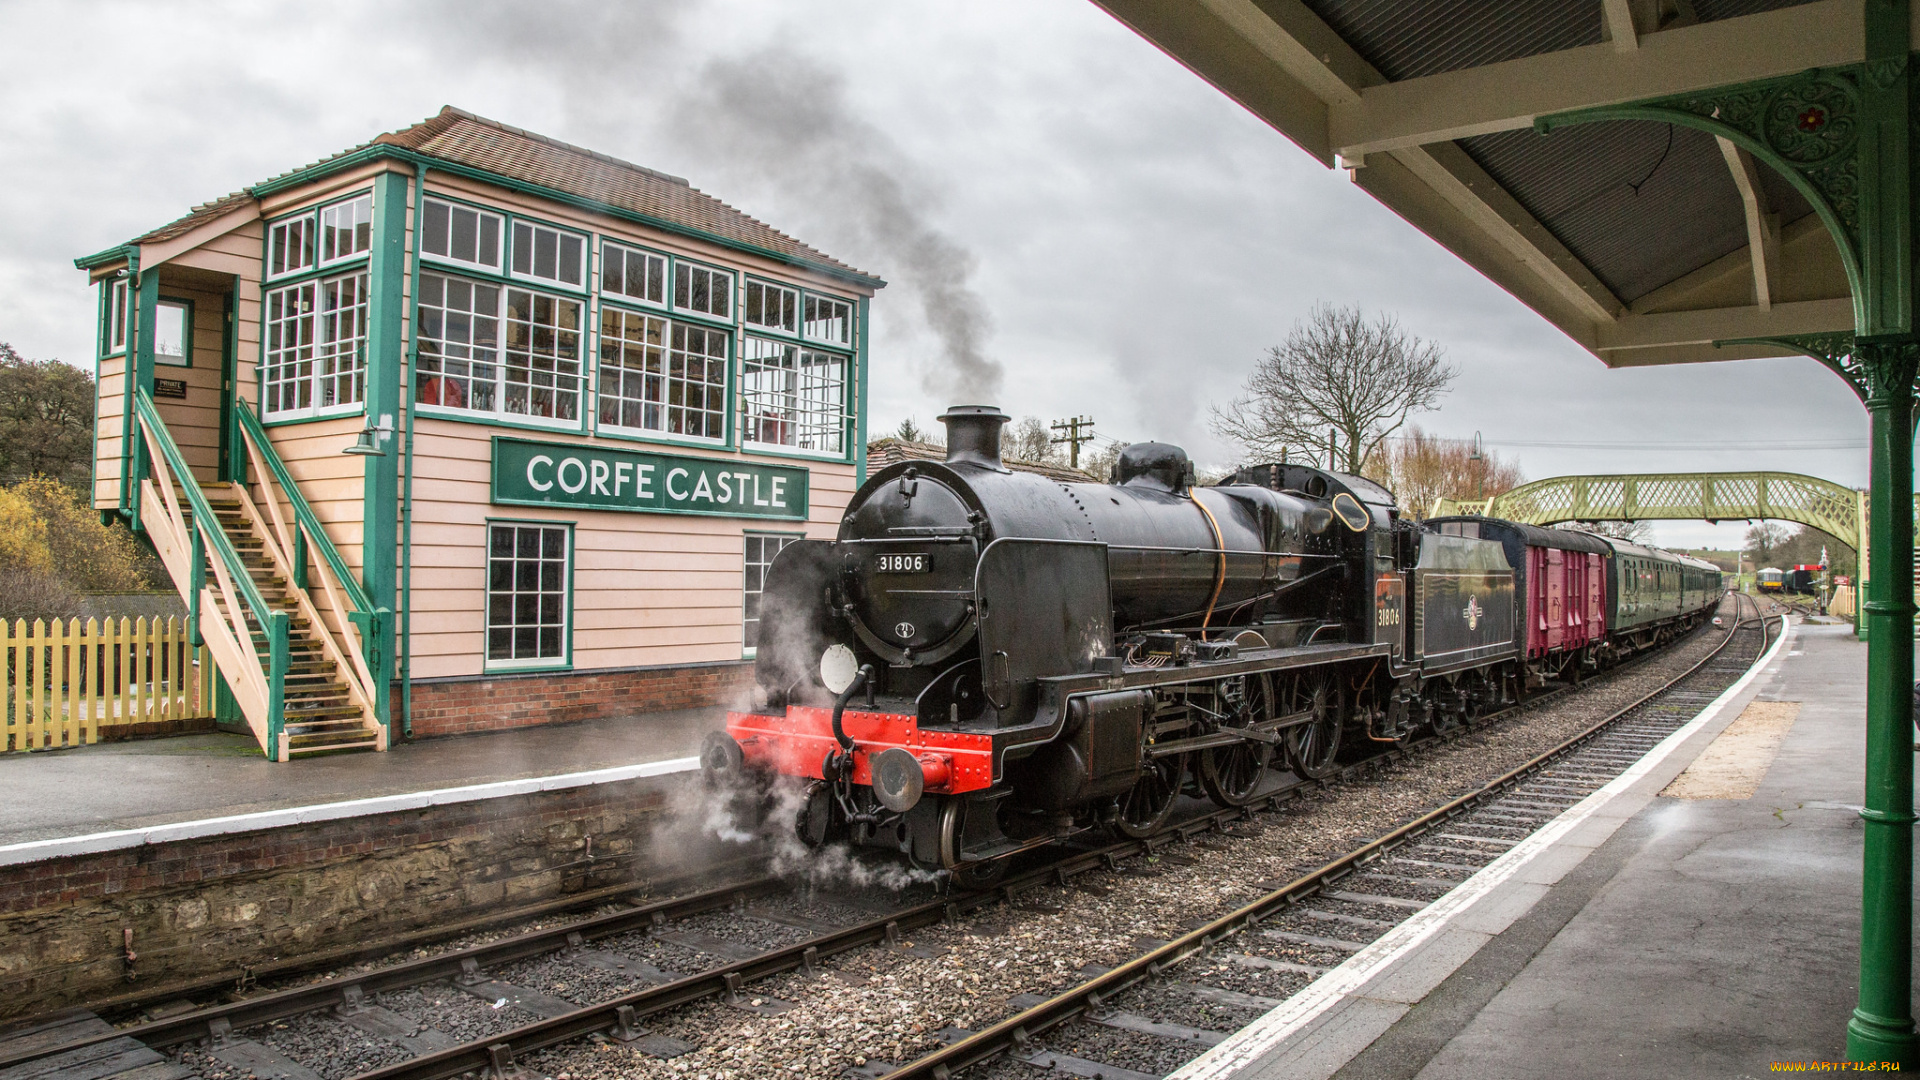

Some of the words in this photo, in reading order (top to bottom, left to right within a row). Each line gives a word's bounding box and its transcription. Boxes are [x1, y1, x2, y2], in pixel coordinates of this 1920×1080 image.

[526, 455, 655, 499] CORFE
[666, 467, 787, 508] CASTLE
[880, 556, 922, 570] 31806
[1378, 609, 1400, 626] 31806
